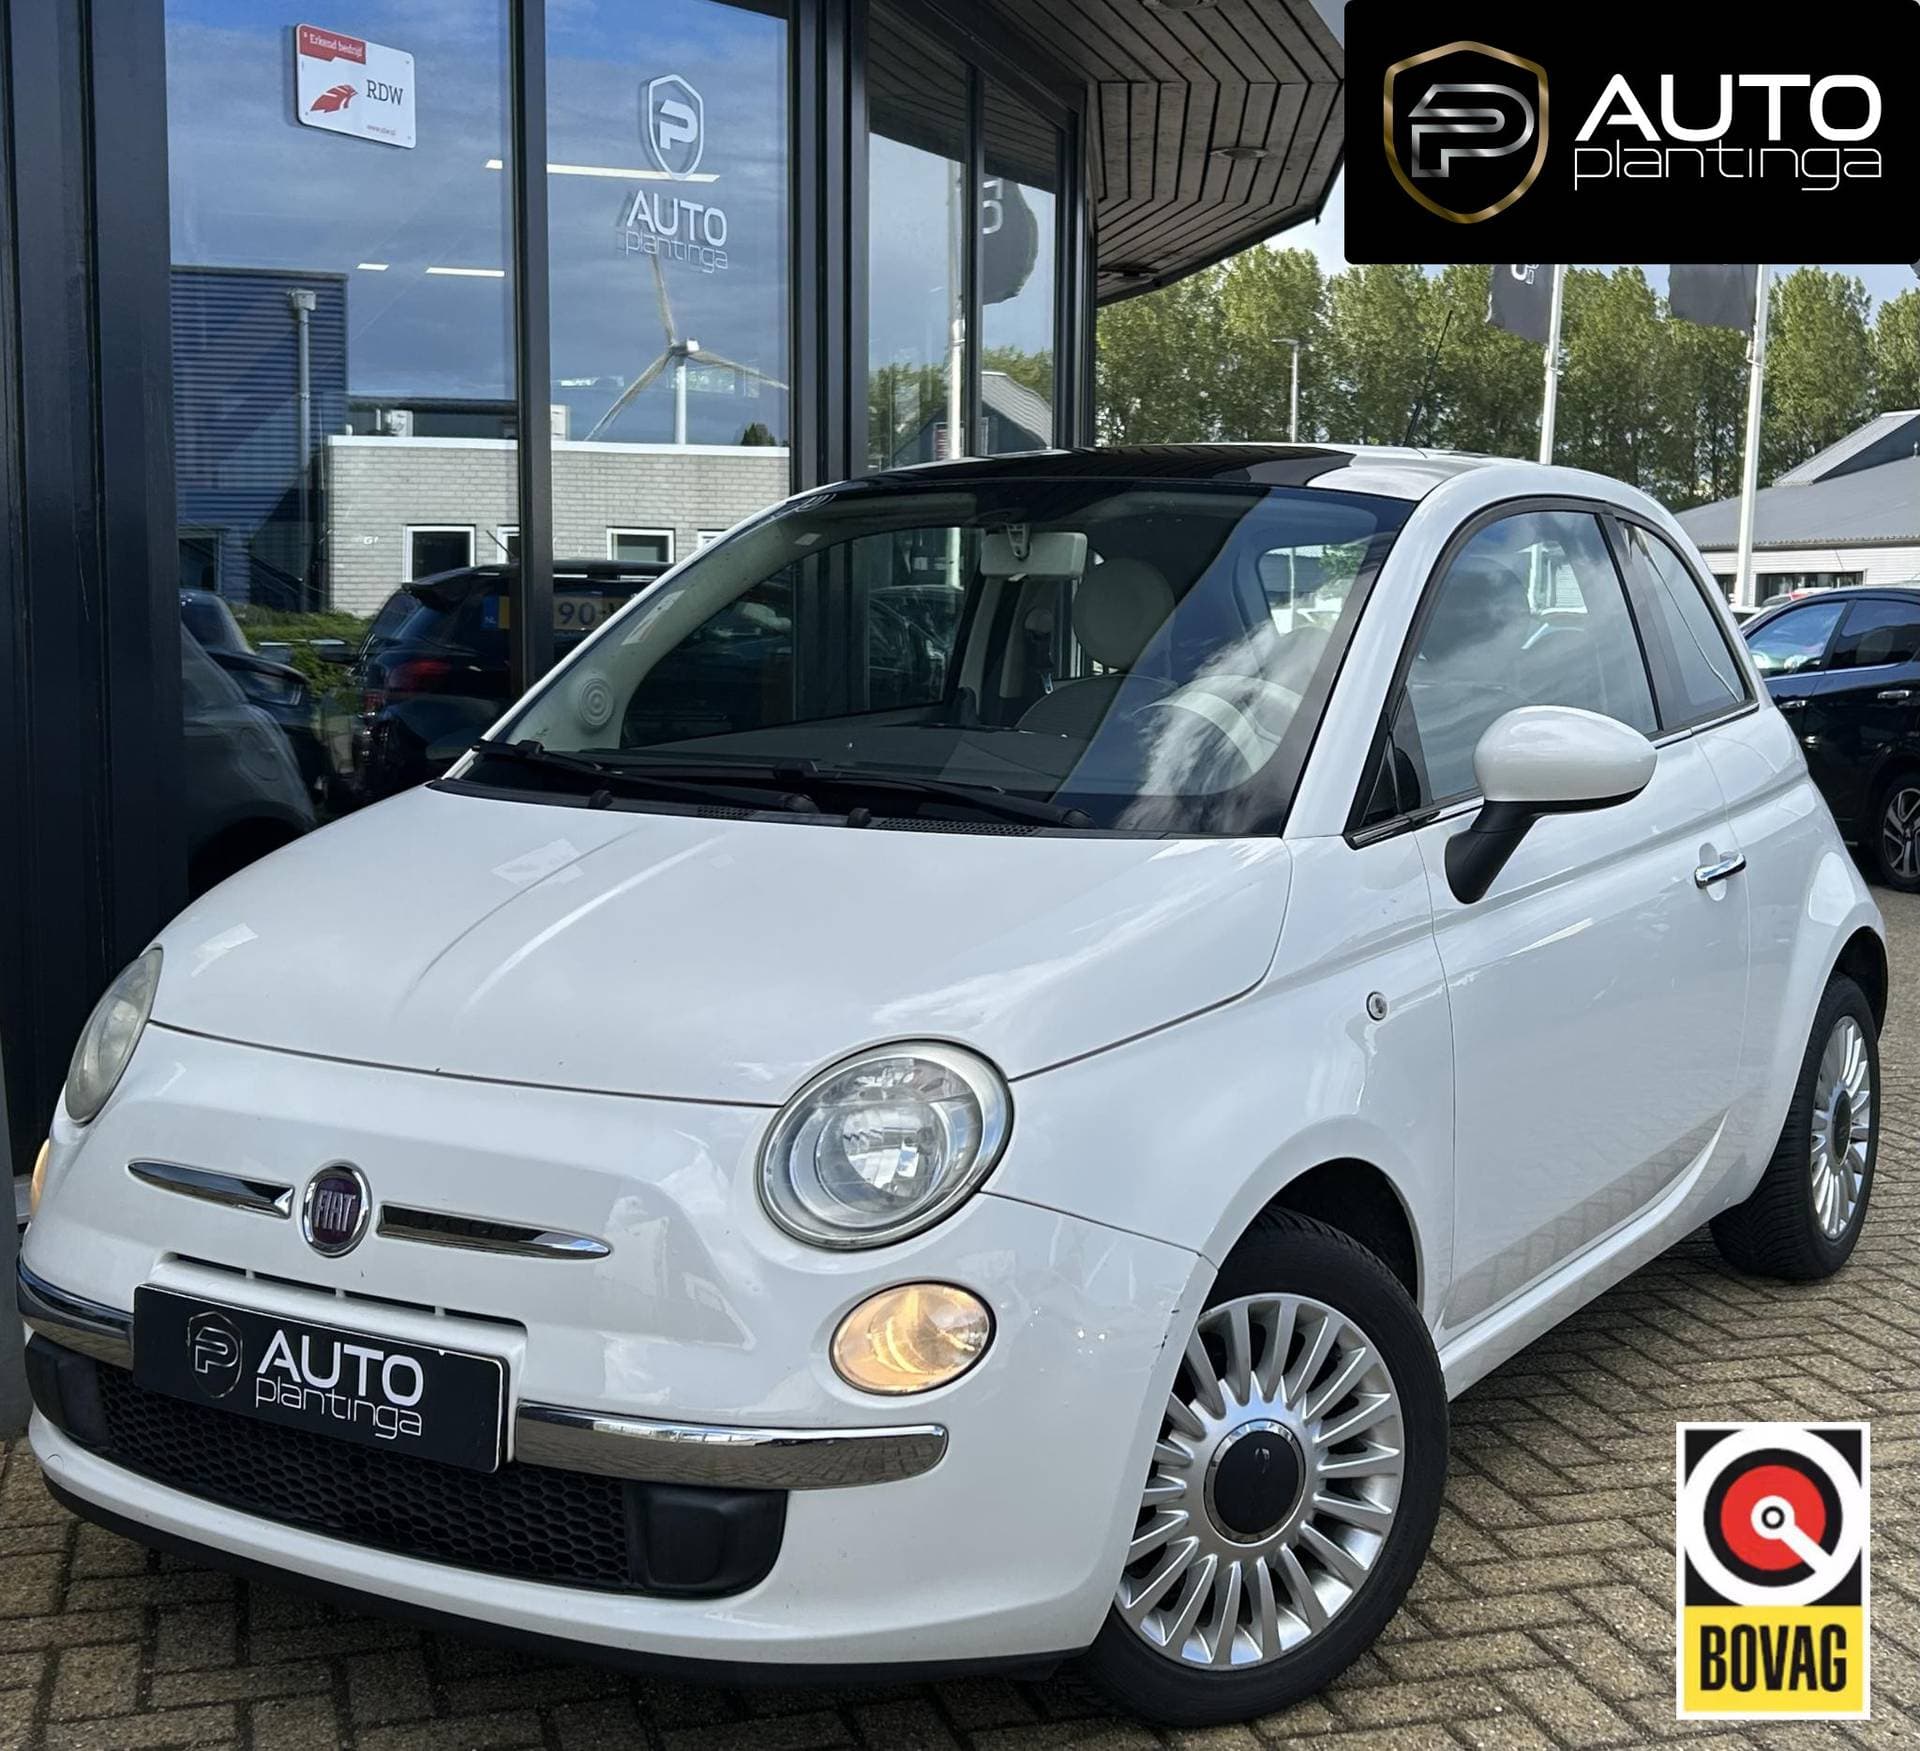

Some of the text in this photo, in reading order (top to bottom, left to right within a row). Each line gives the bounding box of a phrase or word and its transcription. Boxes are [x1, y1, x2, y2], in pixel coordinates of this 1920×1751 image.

[366, 79, 404, 105] RDW
[626, 189, 728, 247] AUTO
[625, 230, 729, 275] plantinga
[314, 1188, 357, 1232] FIAT
[256, 1329, 424, 1407] AUTO
[255, 1376, 423, 1440] plantinga
